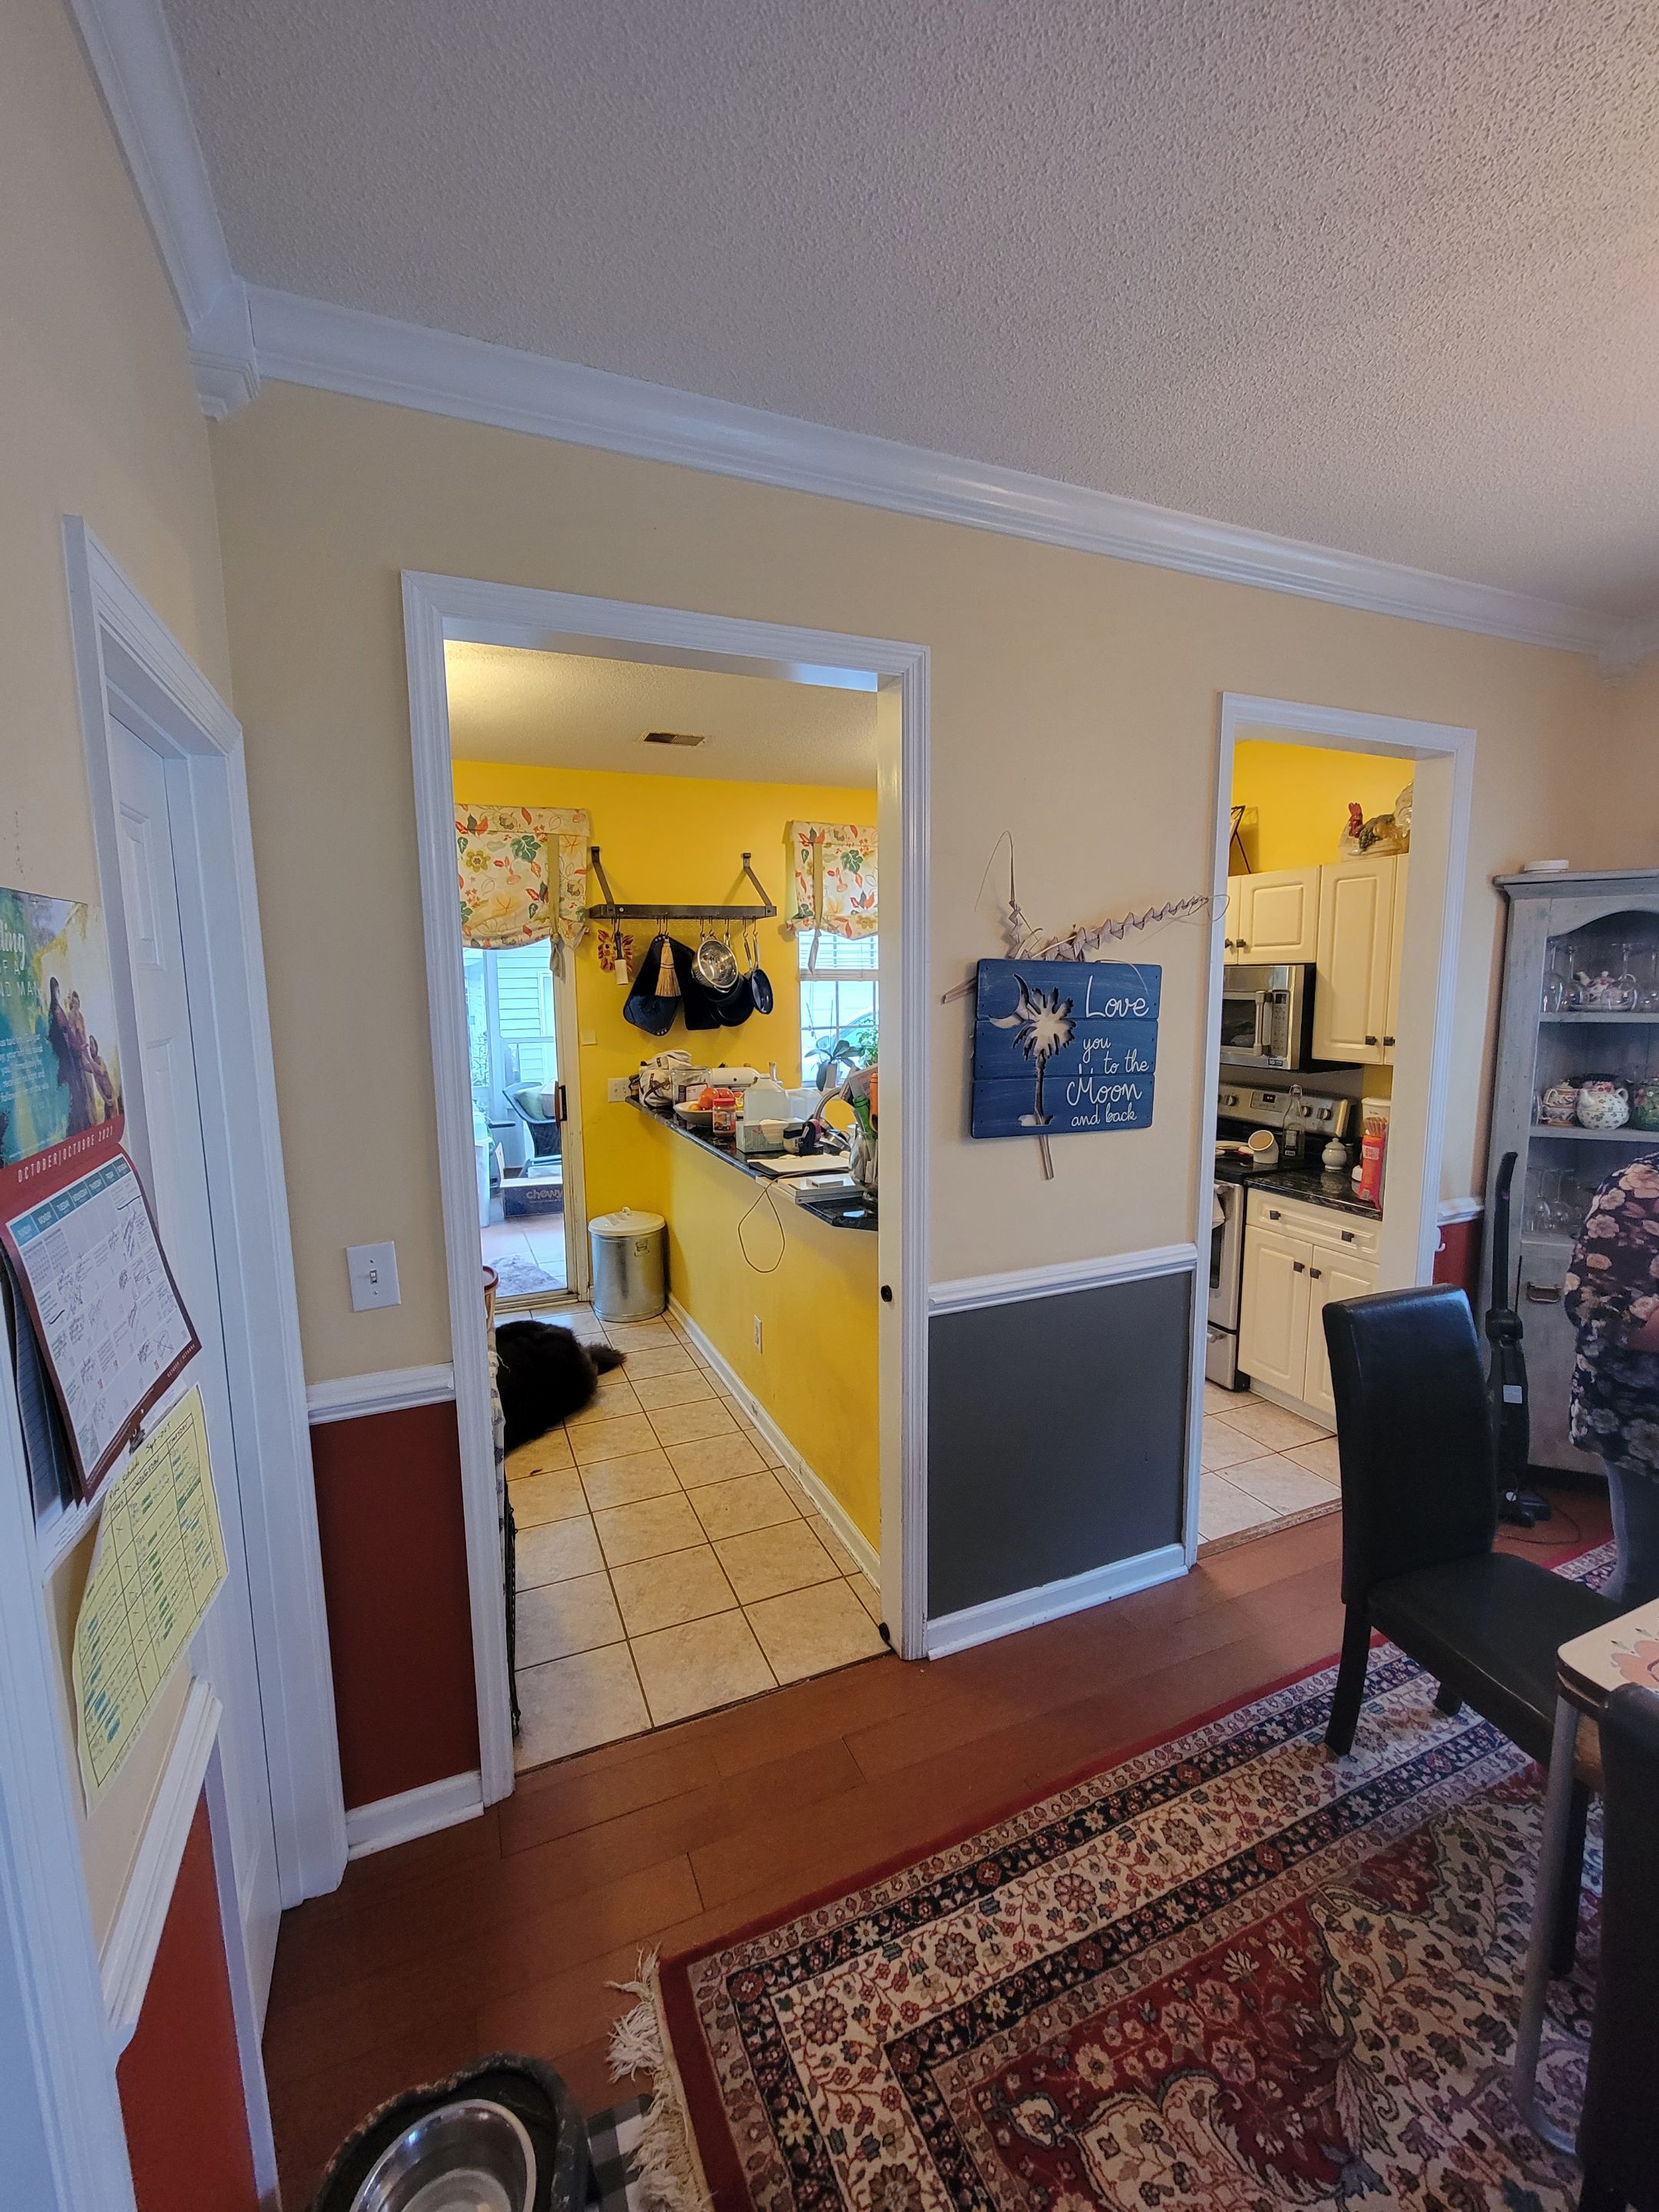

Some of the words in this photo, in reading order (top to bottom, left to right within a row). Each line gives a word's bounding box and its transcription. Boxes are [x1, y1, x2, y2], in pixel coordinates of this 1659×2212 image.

[1085, 975, 1149, 1018] Love
[1082, 1038, 1111, 1064] you
[1103, 1050, 1120, 1074] to
[1124, 1048, 1149, 1073] the
[1066, 1063, 1142, 1106] Moon
[1071, 1104, 1101, 1127] and
[1105, 1101, 1137, 1123] back
[98, 1126, 113, 1142] 2021
[526, 1189, 562, 1200] chewy
